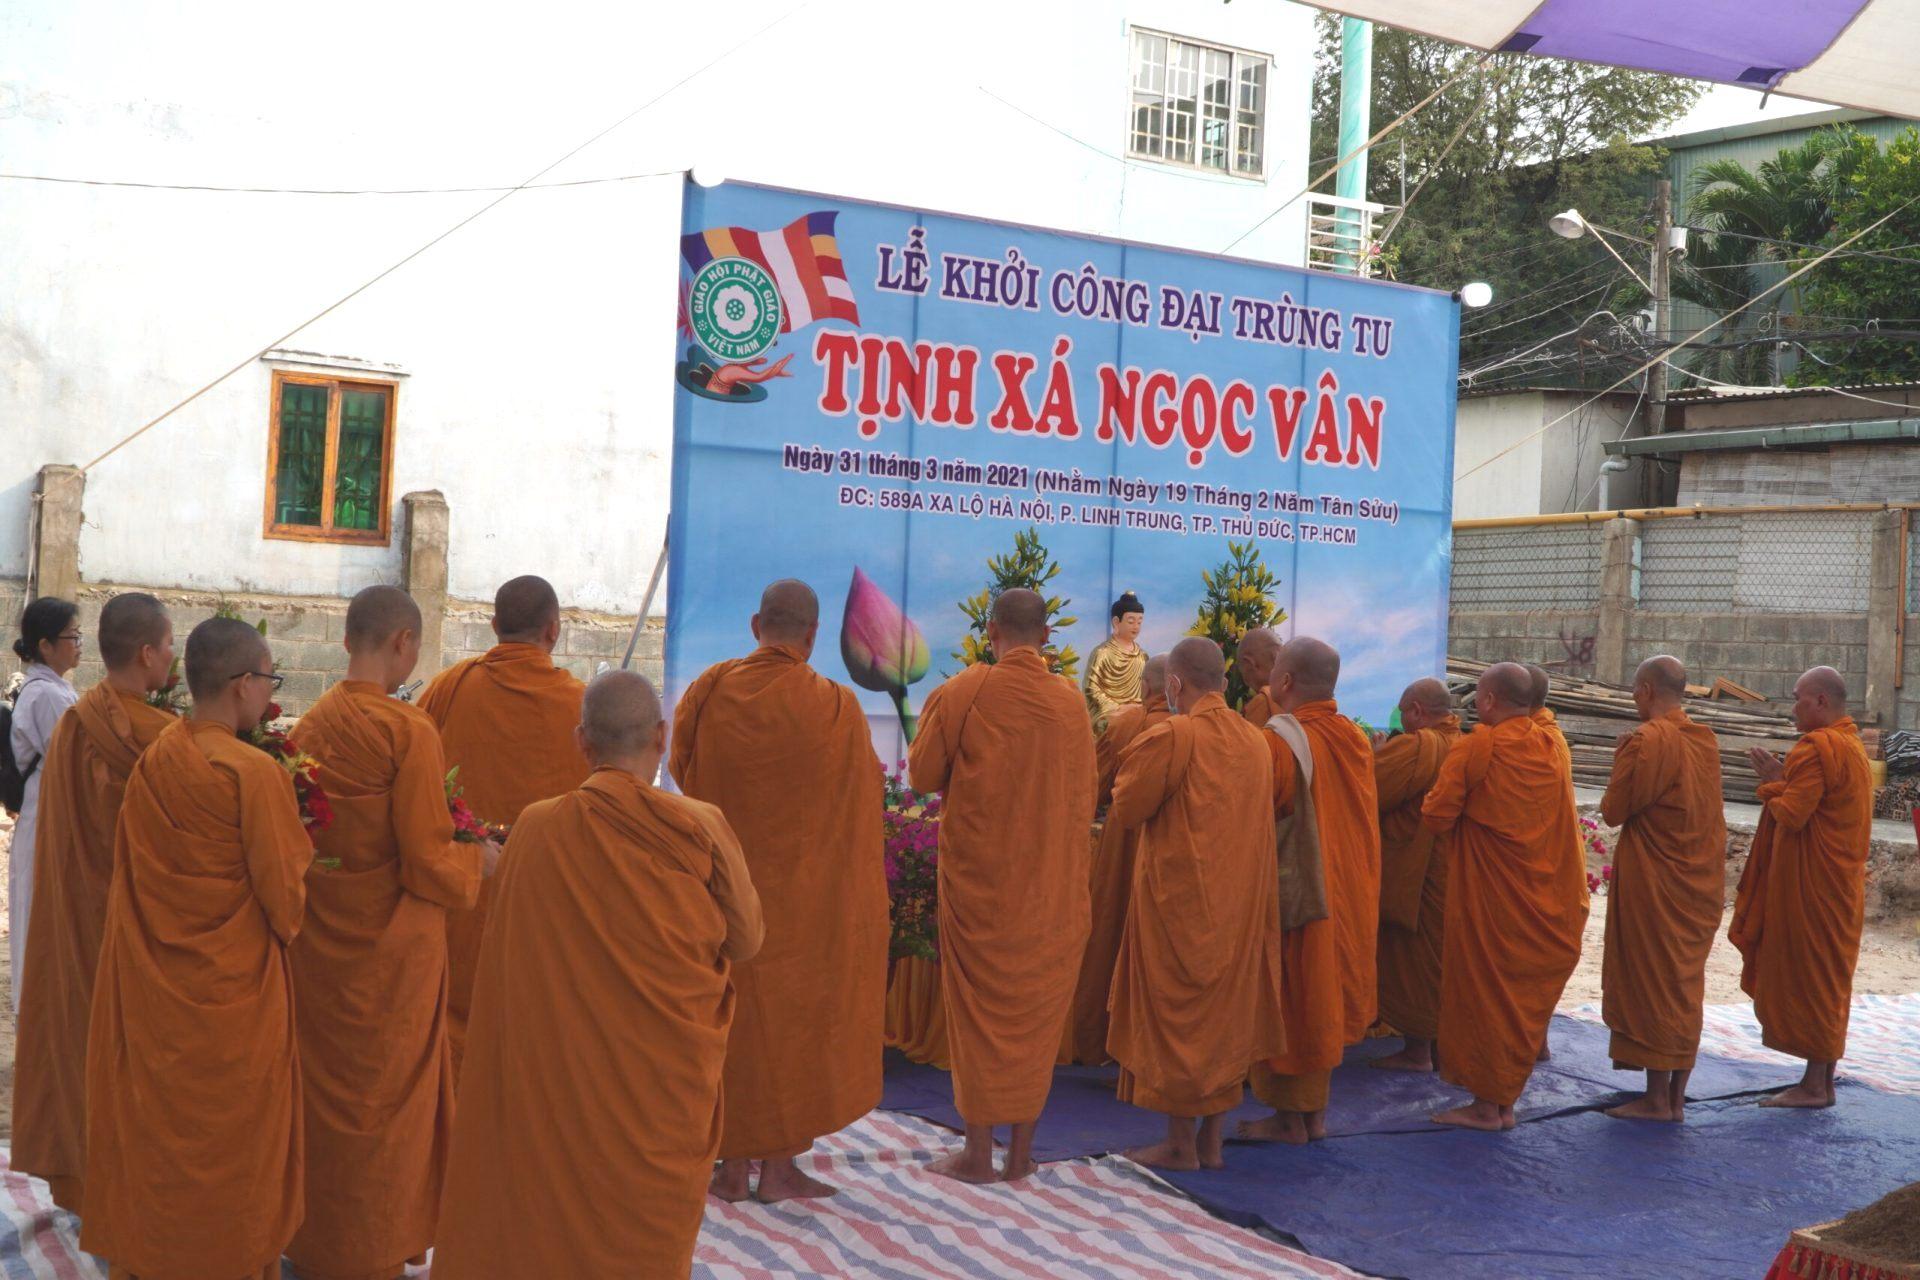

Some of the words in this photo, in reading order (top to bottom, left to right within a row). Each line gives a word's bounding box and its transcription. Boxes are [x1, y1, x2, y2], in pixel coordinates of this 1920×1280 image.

[694, 282, 709, 313] GIÁO
[708, 264, 729, 282] HỘI
[763, 289, 776, 322] GIÁO
[878, 229, 928, 293] LỄ
[943, 250, 1039, 308] KHỞI
[1052, 265, 1149, 323] CÔNG
[1161, 289, 1222, 340] ĐẠI
[1232, 293, 1340, 350] TRÙNG
[1352, 317, 1392, 356] TU
[708, 333, 733, 354] VIỆT
[736, 339, 760, 355] NAM
[817, 332, 977, 435] TỊNH
[991, 339, 1078, 436] XÁ
[1098, 366, 1254, 465] NGỌC
[1269, 372, 1384, 467] VÂN
[784, 445, 834, 473] Ngày
[840, 450, 860, 473] 31
[868, 453, 921, 480] tháng
[926, 458, 937, 480] 3
[943, 460, 981, 483] năm
[987, 464, 1027, 487] 2021
[1035, 469, 1100, 494] (Nhằm
[1108, 477, 1158, 503] Ngày
[1166, 483, 1187, 501] 19
[1193, 485, 1252, 512] Tháng
[1258, 491, 1268, 509] 2
[1274, 492, 1314, 512] Năm
[1320, 496, 1353, 516] Tân
[1359, 498, 1398, 524] Sửu)
[840, 487, 873, 506] ĐC:
[880, 491, 923, 510] 589A
[929, 494, 953, 512] XA
[960, 493, 983, 517] LỘ
[989, 496, 1013, 517] HÀ
[1020, 499, 1054, 523] NỘI,
[1061, 505, 1076, 522] P.
[1082, 507, 1120, 525] LINH
[1125, 511, 1187, 533] TRUNG,
[1192, 516, 1216, 533] TP.
[1222, 514, 1252, 535] THỦ
[1258, 519, 1295, 540] ĐỨC,
[1300, 525, 1356, 544] TP.HCM
